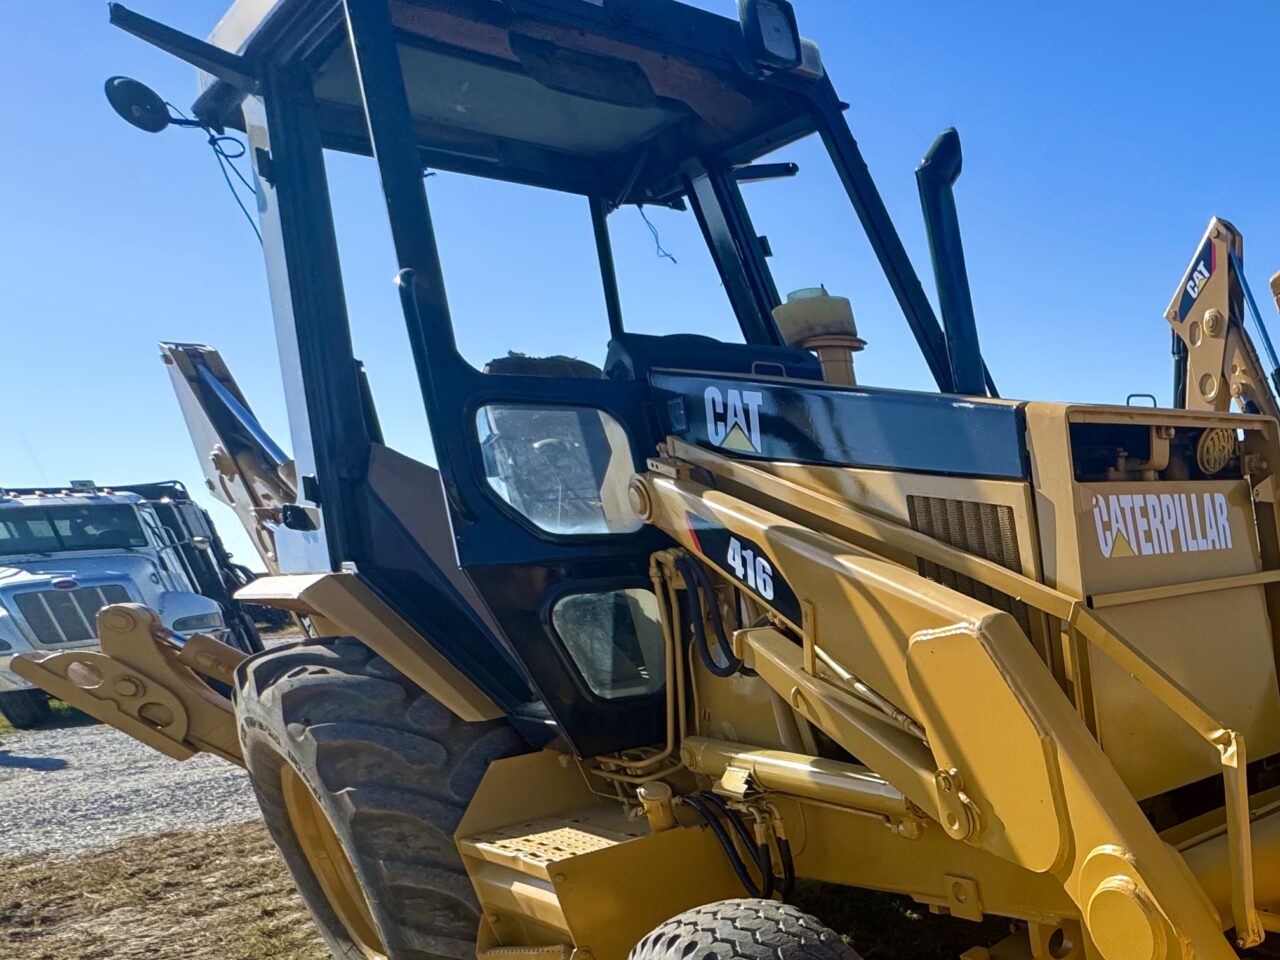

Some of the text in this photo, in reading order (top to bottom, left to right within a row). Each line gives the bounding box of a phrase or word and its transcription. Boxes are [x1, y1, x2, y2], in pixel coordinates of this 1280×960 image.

[1186, 260, 1211, 299] CAT
[704, 386, 763, 453] CAT
[1092, 493, 1232, 558] CATERPILLAR
[727, 536, 774, 601] 416
